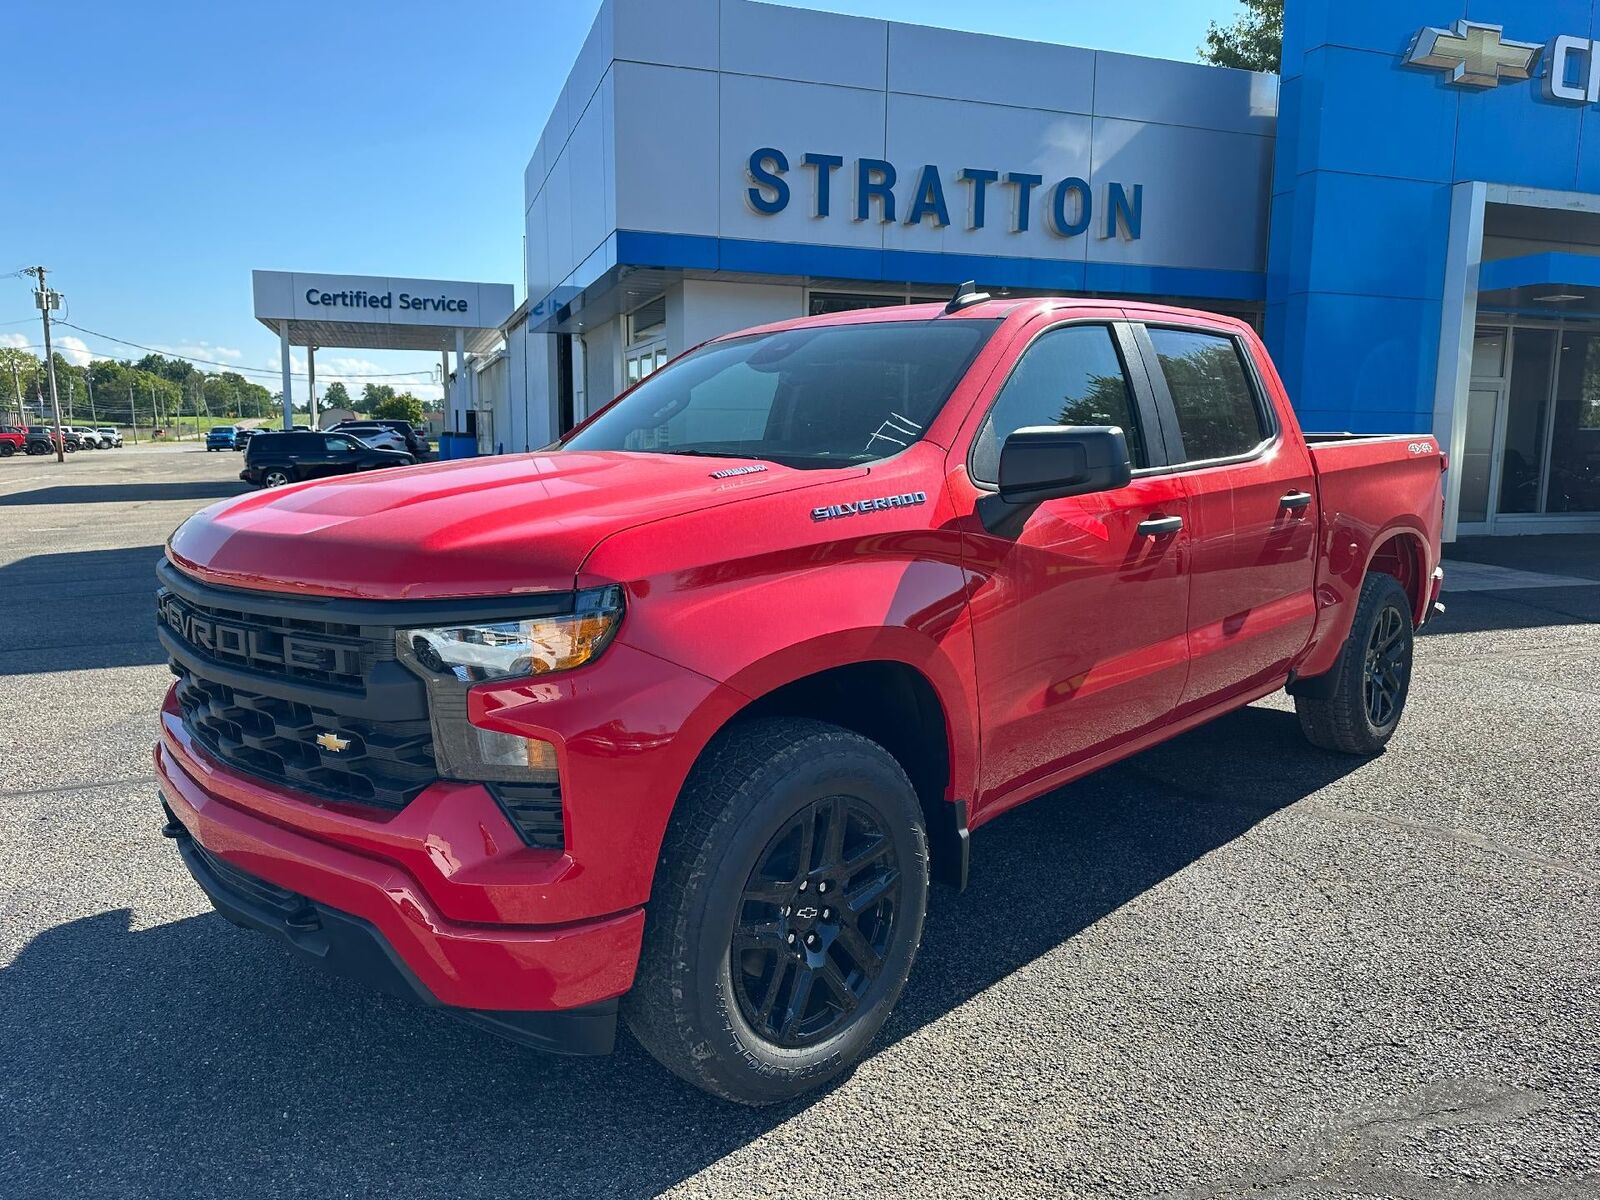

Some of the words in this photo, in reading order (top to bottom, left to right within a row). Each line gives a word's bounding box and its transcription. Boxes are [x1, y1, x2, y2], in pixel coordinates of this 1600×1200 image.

[745, 147, 1143, 241] STRATTON
[305, 288, 392, 309] Certified
[399, 293, 468, 312] Service
[811, 491, 927, 522] SILVERADO
